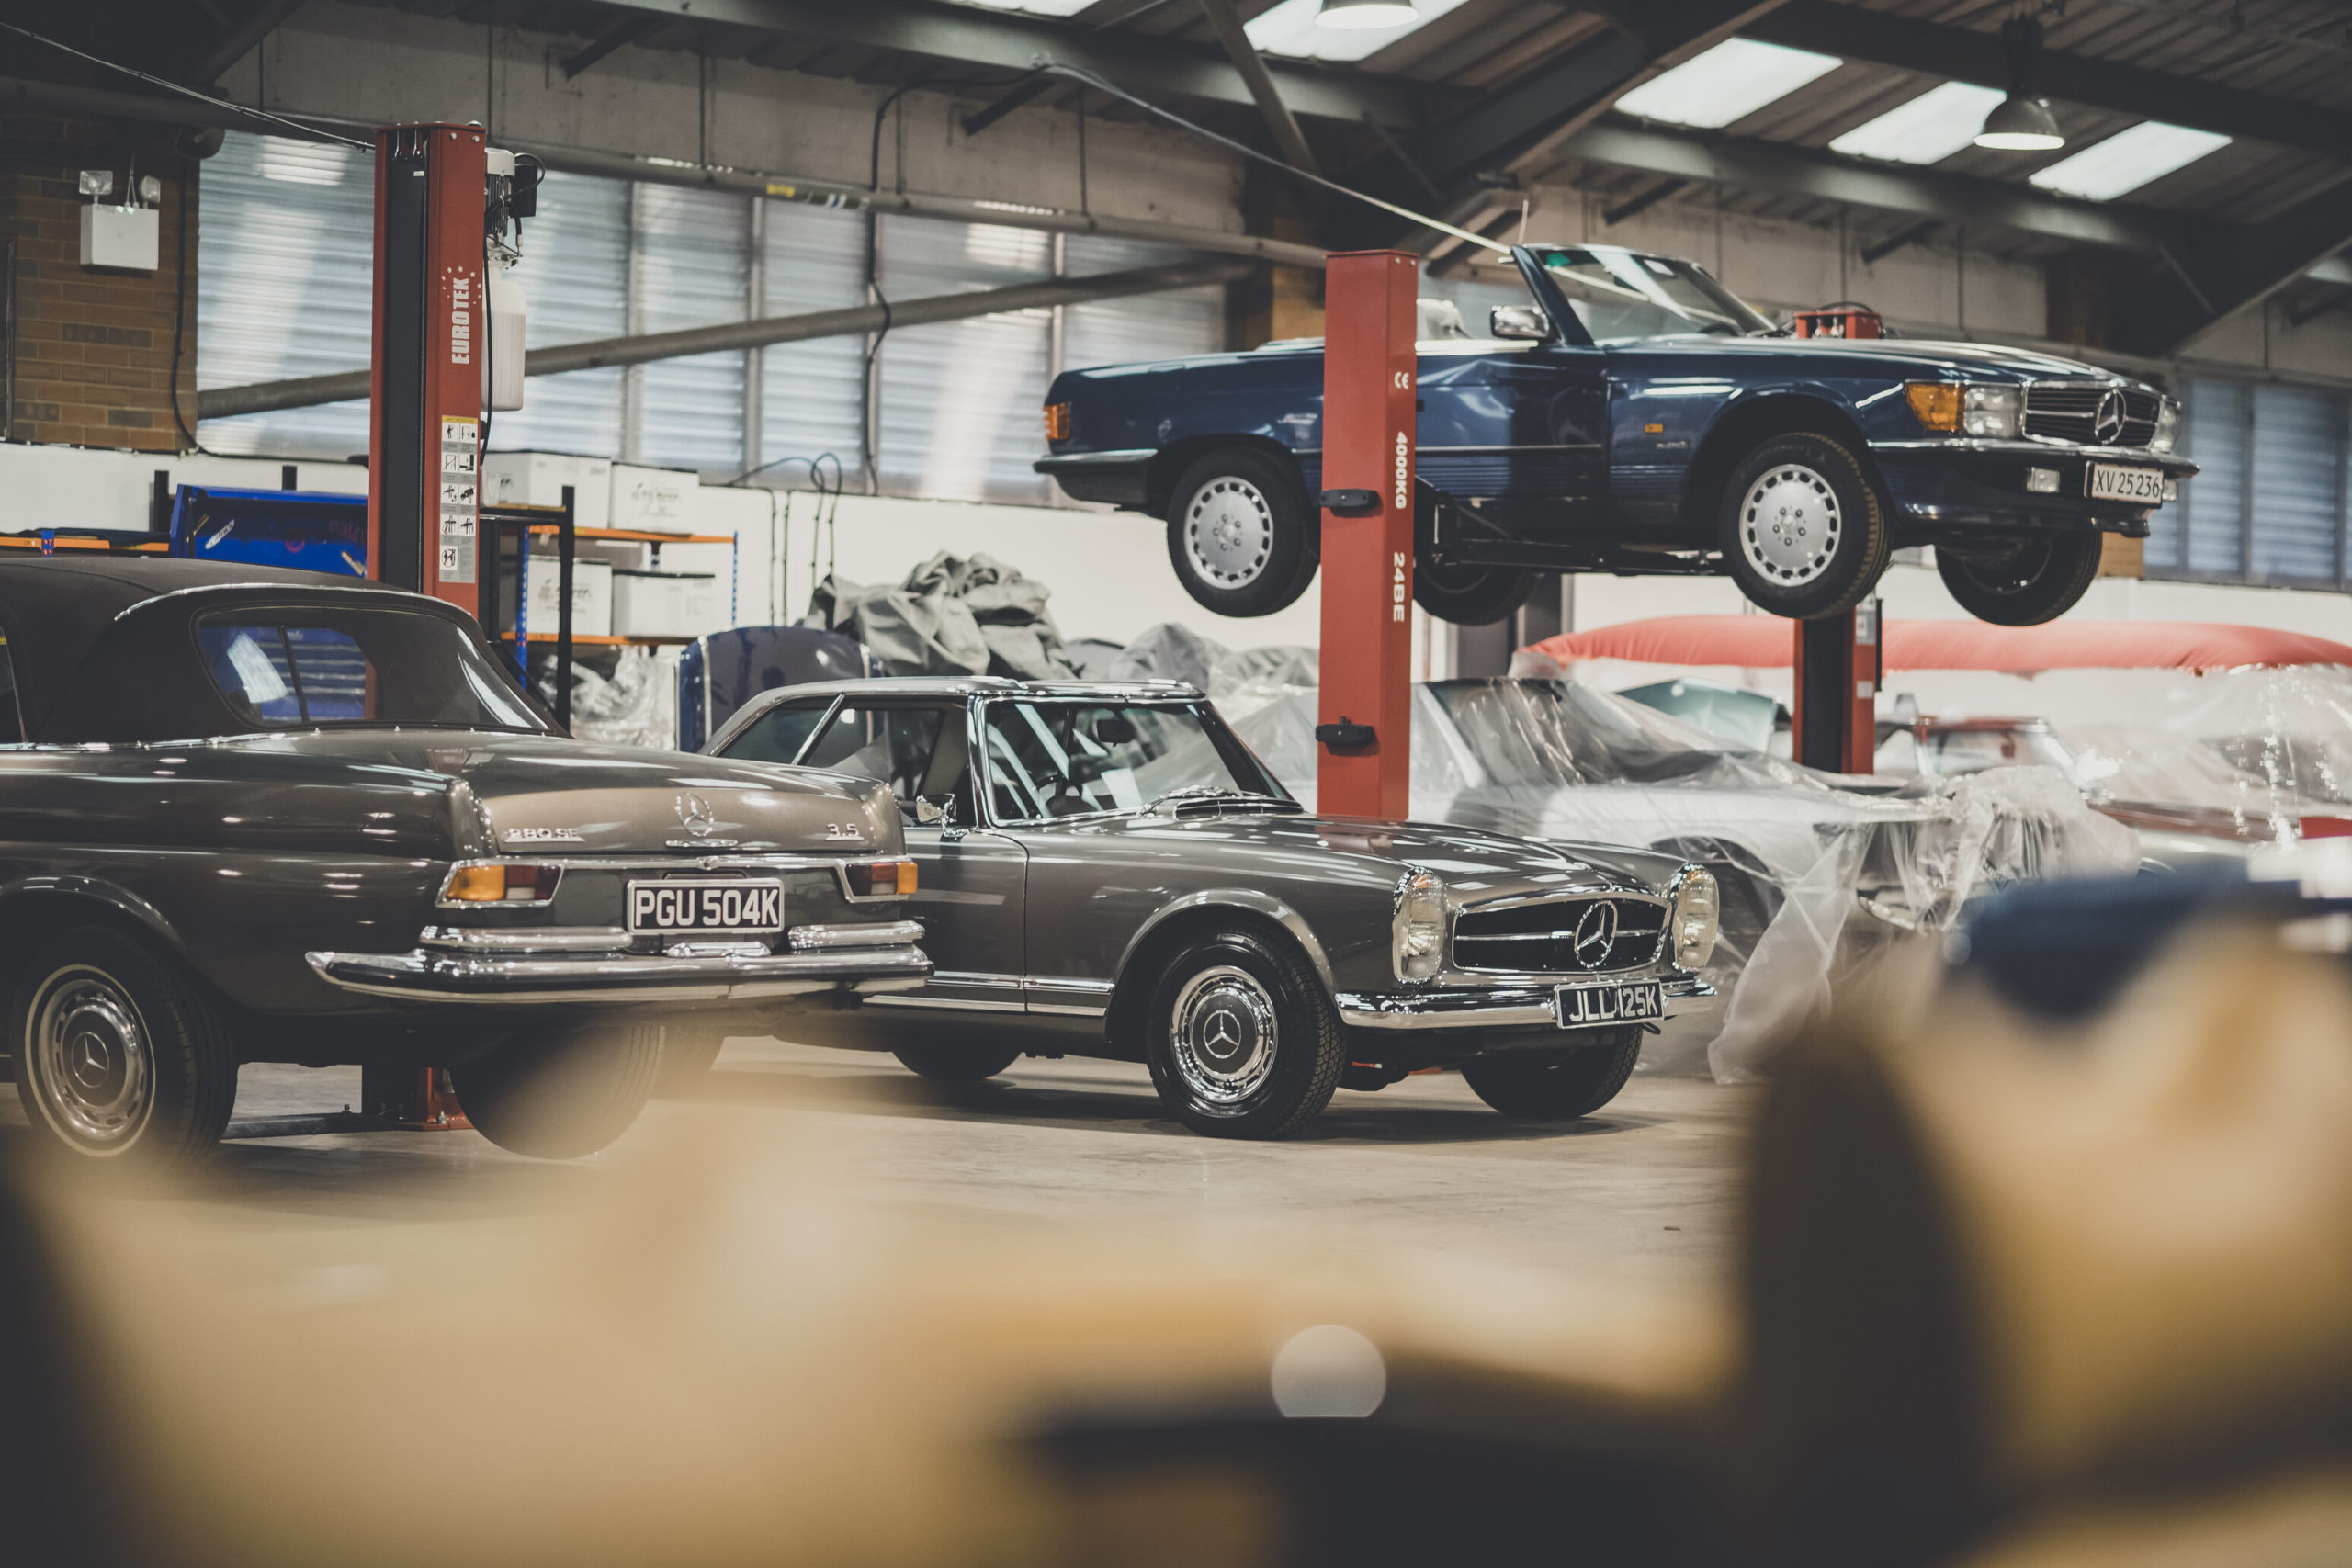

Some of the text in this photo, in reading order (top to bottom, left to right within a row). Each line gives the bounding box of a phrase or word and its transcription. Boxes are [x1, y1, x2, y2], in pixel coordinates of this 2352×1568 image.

[451, 277, 470, 364] EUROTEK
[1395, 431, 1408, 510] 4000KG
[2096, 469, 2116, 492] XV
[1393, 551, 1406, 623] 24BE
[508, 828, 579, 839] 280 SE
[827, 823, 859, 837] 3.5
[635, 889, 779, 927] PGU 504K
[1569, 986, 1658, 1022] JLL 125K
